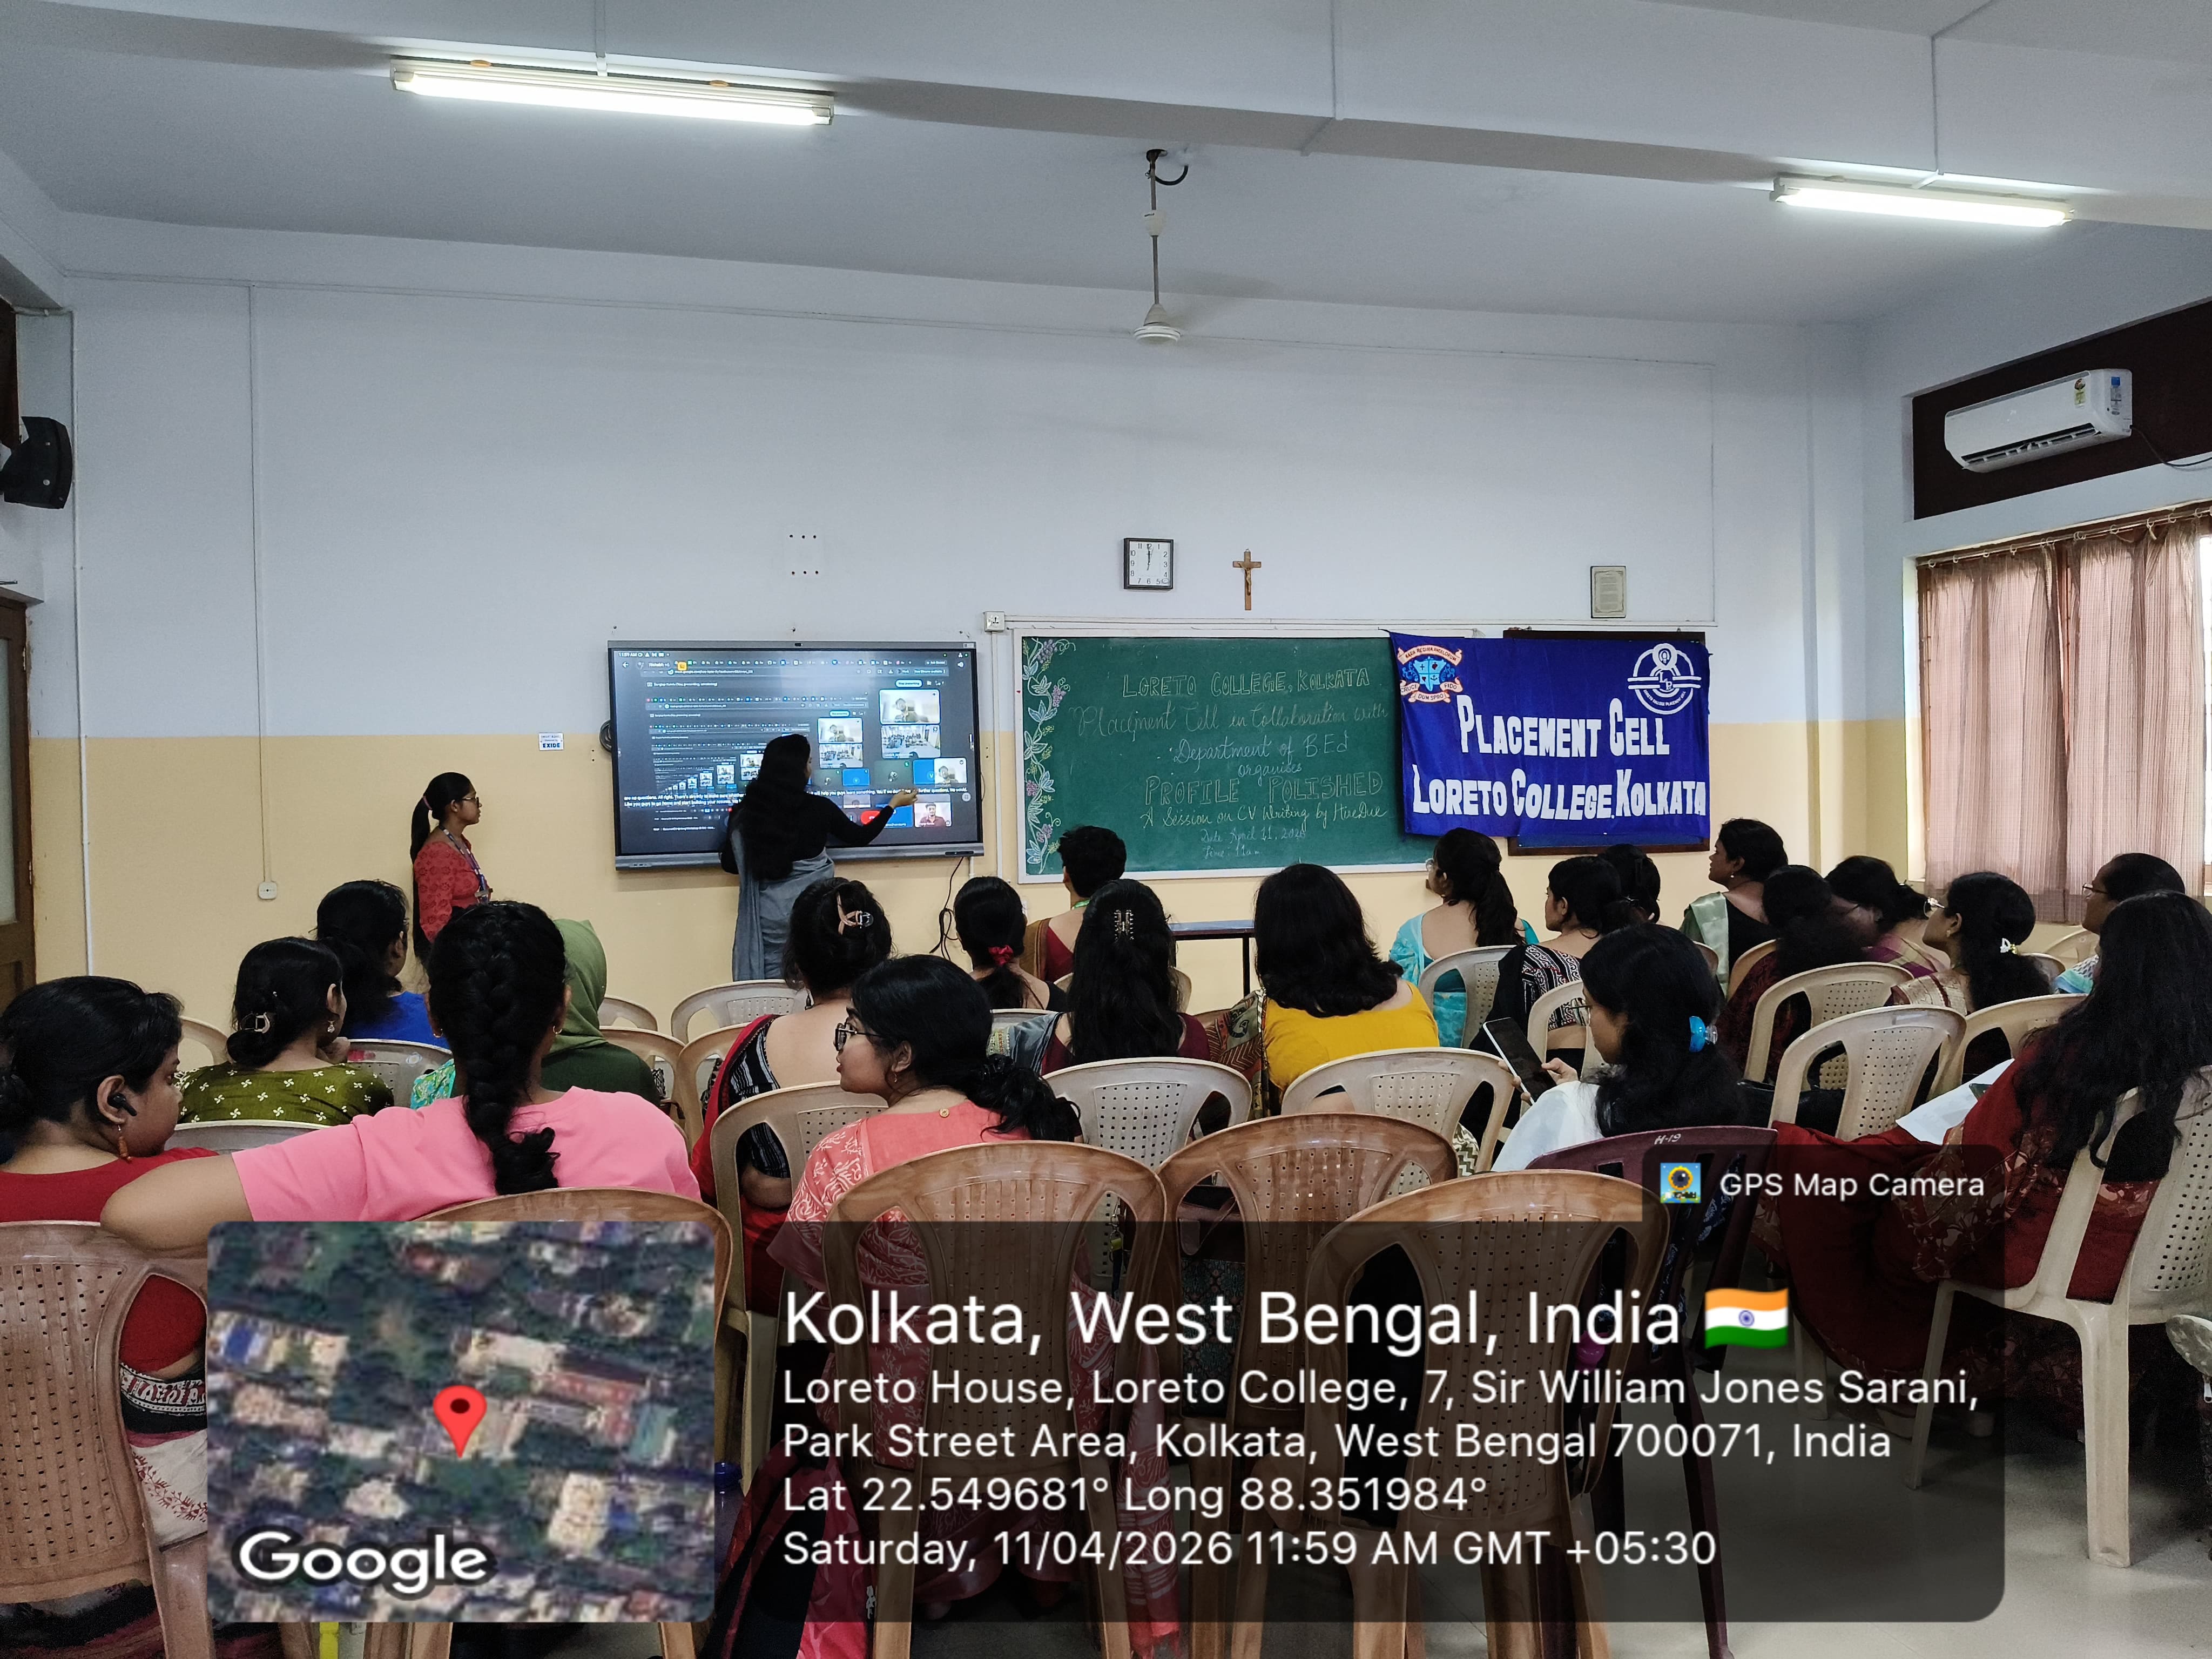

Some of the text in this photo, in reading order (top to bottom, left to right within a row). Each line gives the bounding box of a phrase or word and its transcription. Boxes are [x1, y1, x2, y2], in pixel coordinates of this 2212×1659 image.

[1434, 648, 1456, 662] ANGELORUM
[1123, 668, 1370, 698] LORETO COLLEGE, KOLKATA
[1180, 702, 1219, 732] Cell
[1229, 711, 1247, 727] in
[1250, 700, 1348, 729] Collaboration
[1456, 694, 1670, 757] PLACEMENT CELL
[1174, 730, 1348, 773] Department of B.Ed
[1145, 771, 1383, 805] PROFILE POLISHED
[1413, 764, 1507, 817] LORETO
[1616, 768, 1707, 817] KOLKATA
[1140, 806, 1154, 828] A
[1216, 812, 1233, 824] on
[1237, 806, 1256, 821] CV
[1263, 804, 1310, 833] Writing
[1316, 802, 1328, 830] by
[1654, 1134, 1681, 1145] H-19
